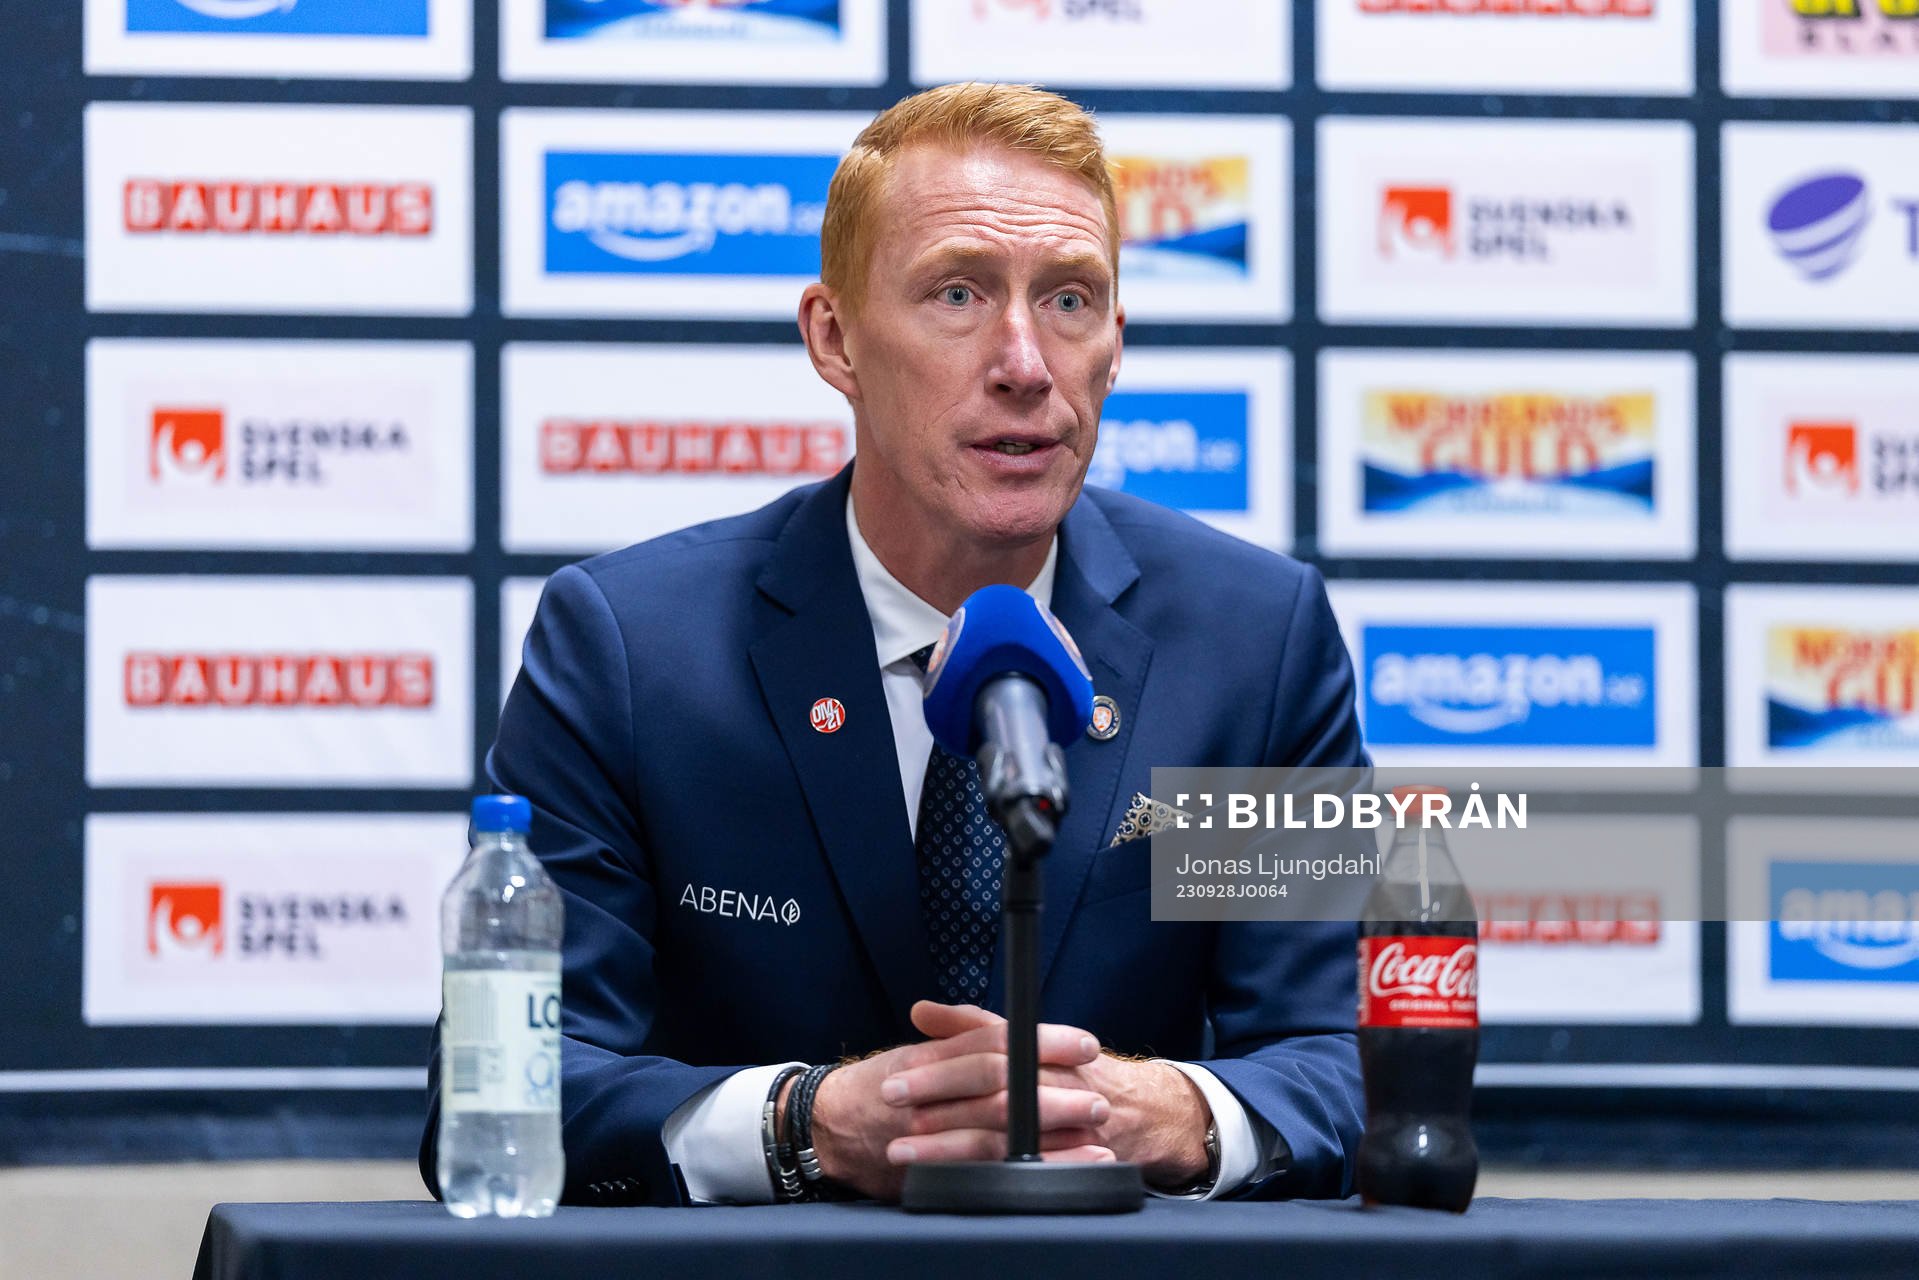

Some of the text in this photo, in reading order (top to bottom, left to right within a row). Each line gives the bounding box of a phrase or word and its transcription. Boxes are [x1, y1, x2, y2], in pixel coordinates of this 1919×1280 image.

[124, 180, 432, 235] BAUHAUS
[1469, 197, 1634, 229] SVENSKA
[1469, 232, 1552, 258] SPEL
[242, 418, 408, 450] SVENSKA
[541, 418, 850, 475] BAUHAUS
[242, 453, 325, 481] SPEL
[124, 652, 433, 707] BAUHAUS
[240, 894, 405, 925] SVENSKA
[680, 883, 779, 923] ABENA
[240, 928, 322, 957] SPEL
[528, 993, 561, 1028] LO
